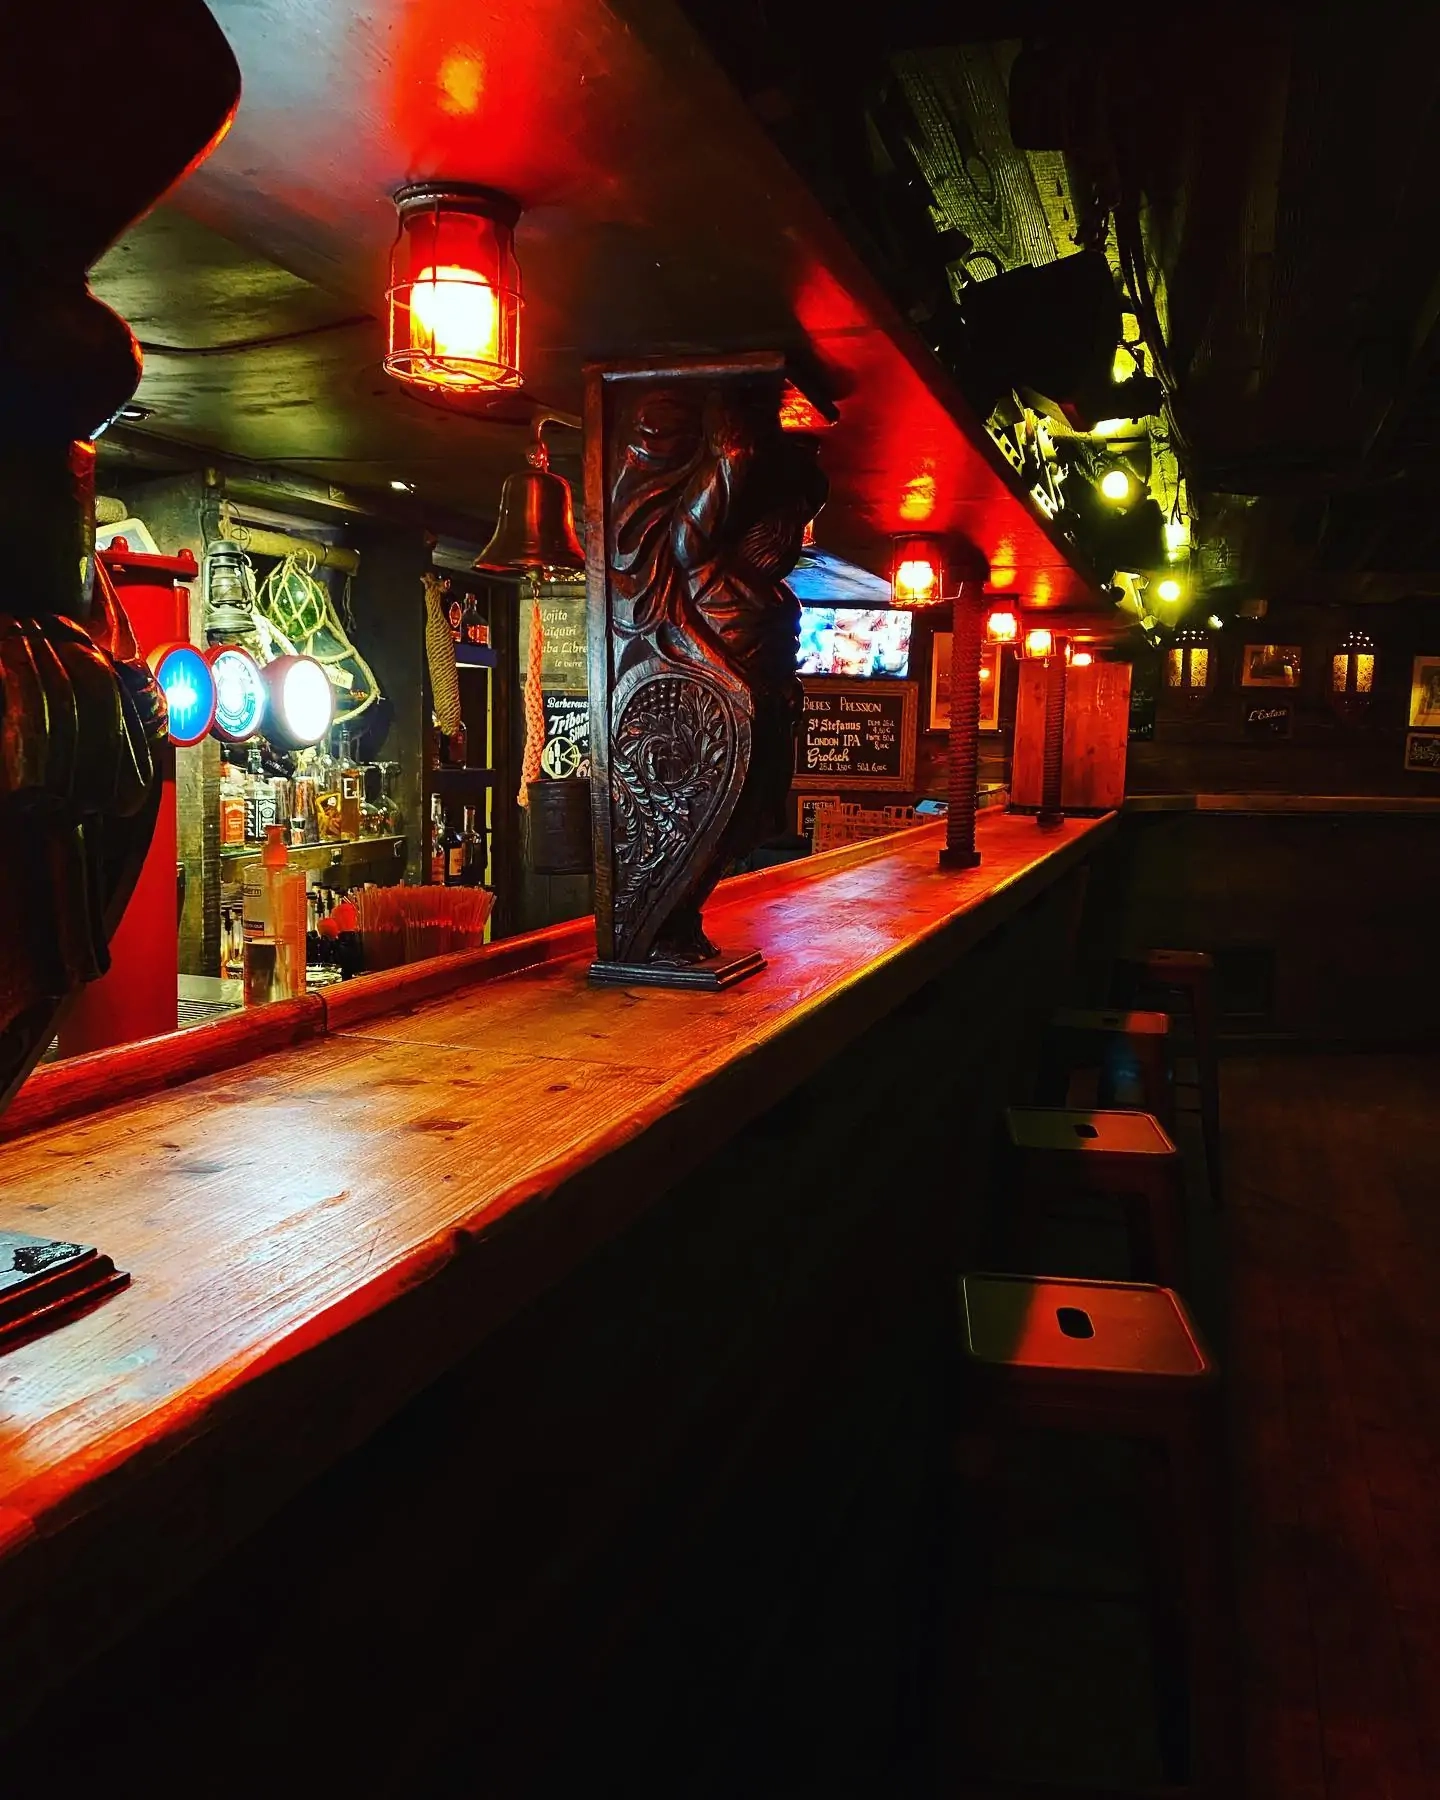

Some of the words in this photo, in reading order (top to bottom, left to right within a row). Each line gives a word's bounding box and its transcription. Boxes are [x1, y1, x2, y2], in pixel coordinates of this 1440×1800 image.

[840, 696, 882, 713] PRESSION
[807, 718, 819, 732] St
[820, 718, 861, 734] Stefanus
[843, 734, 861, 747] IPA
[807, 747, 850, 769] Grolsch
